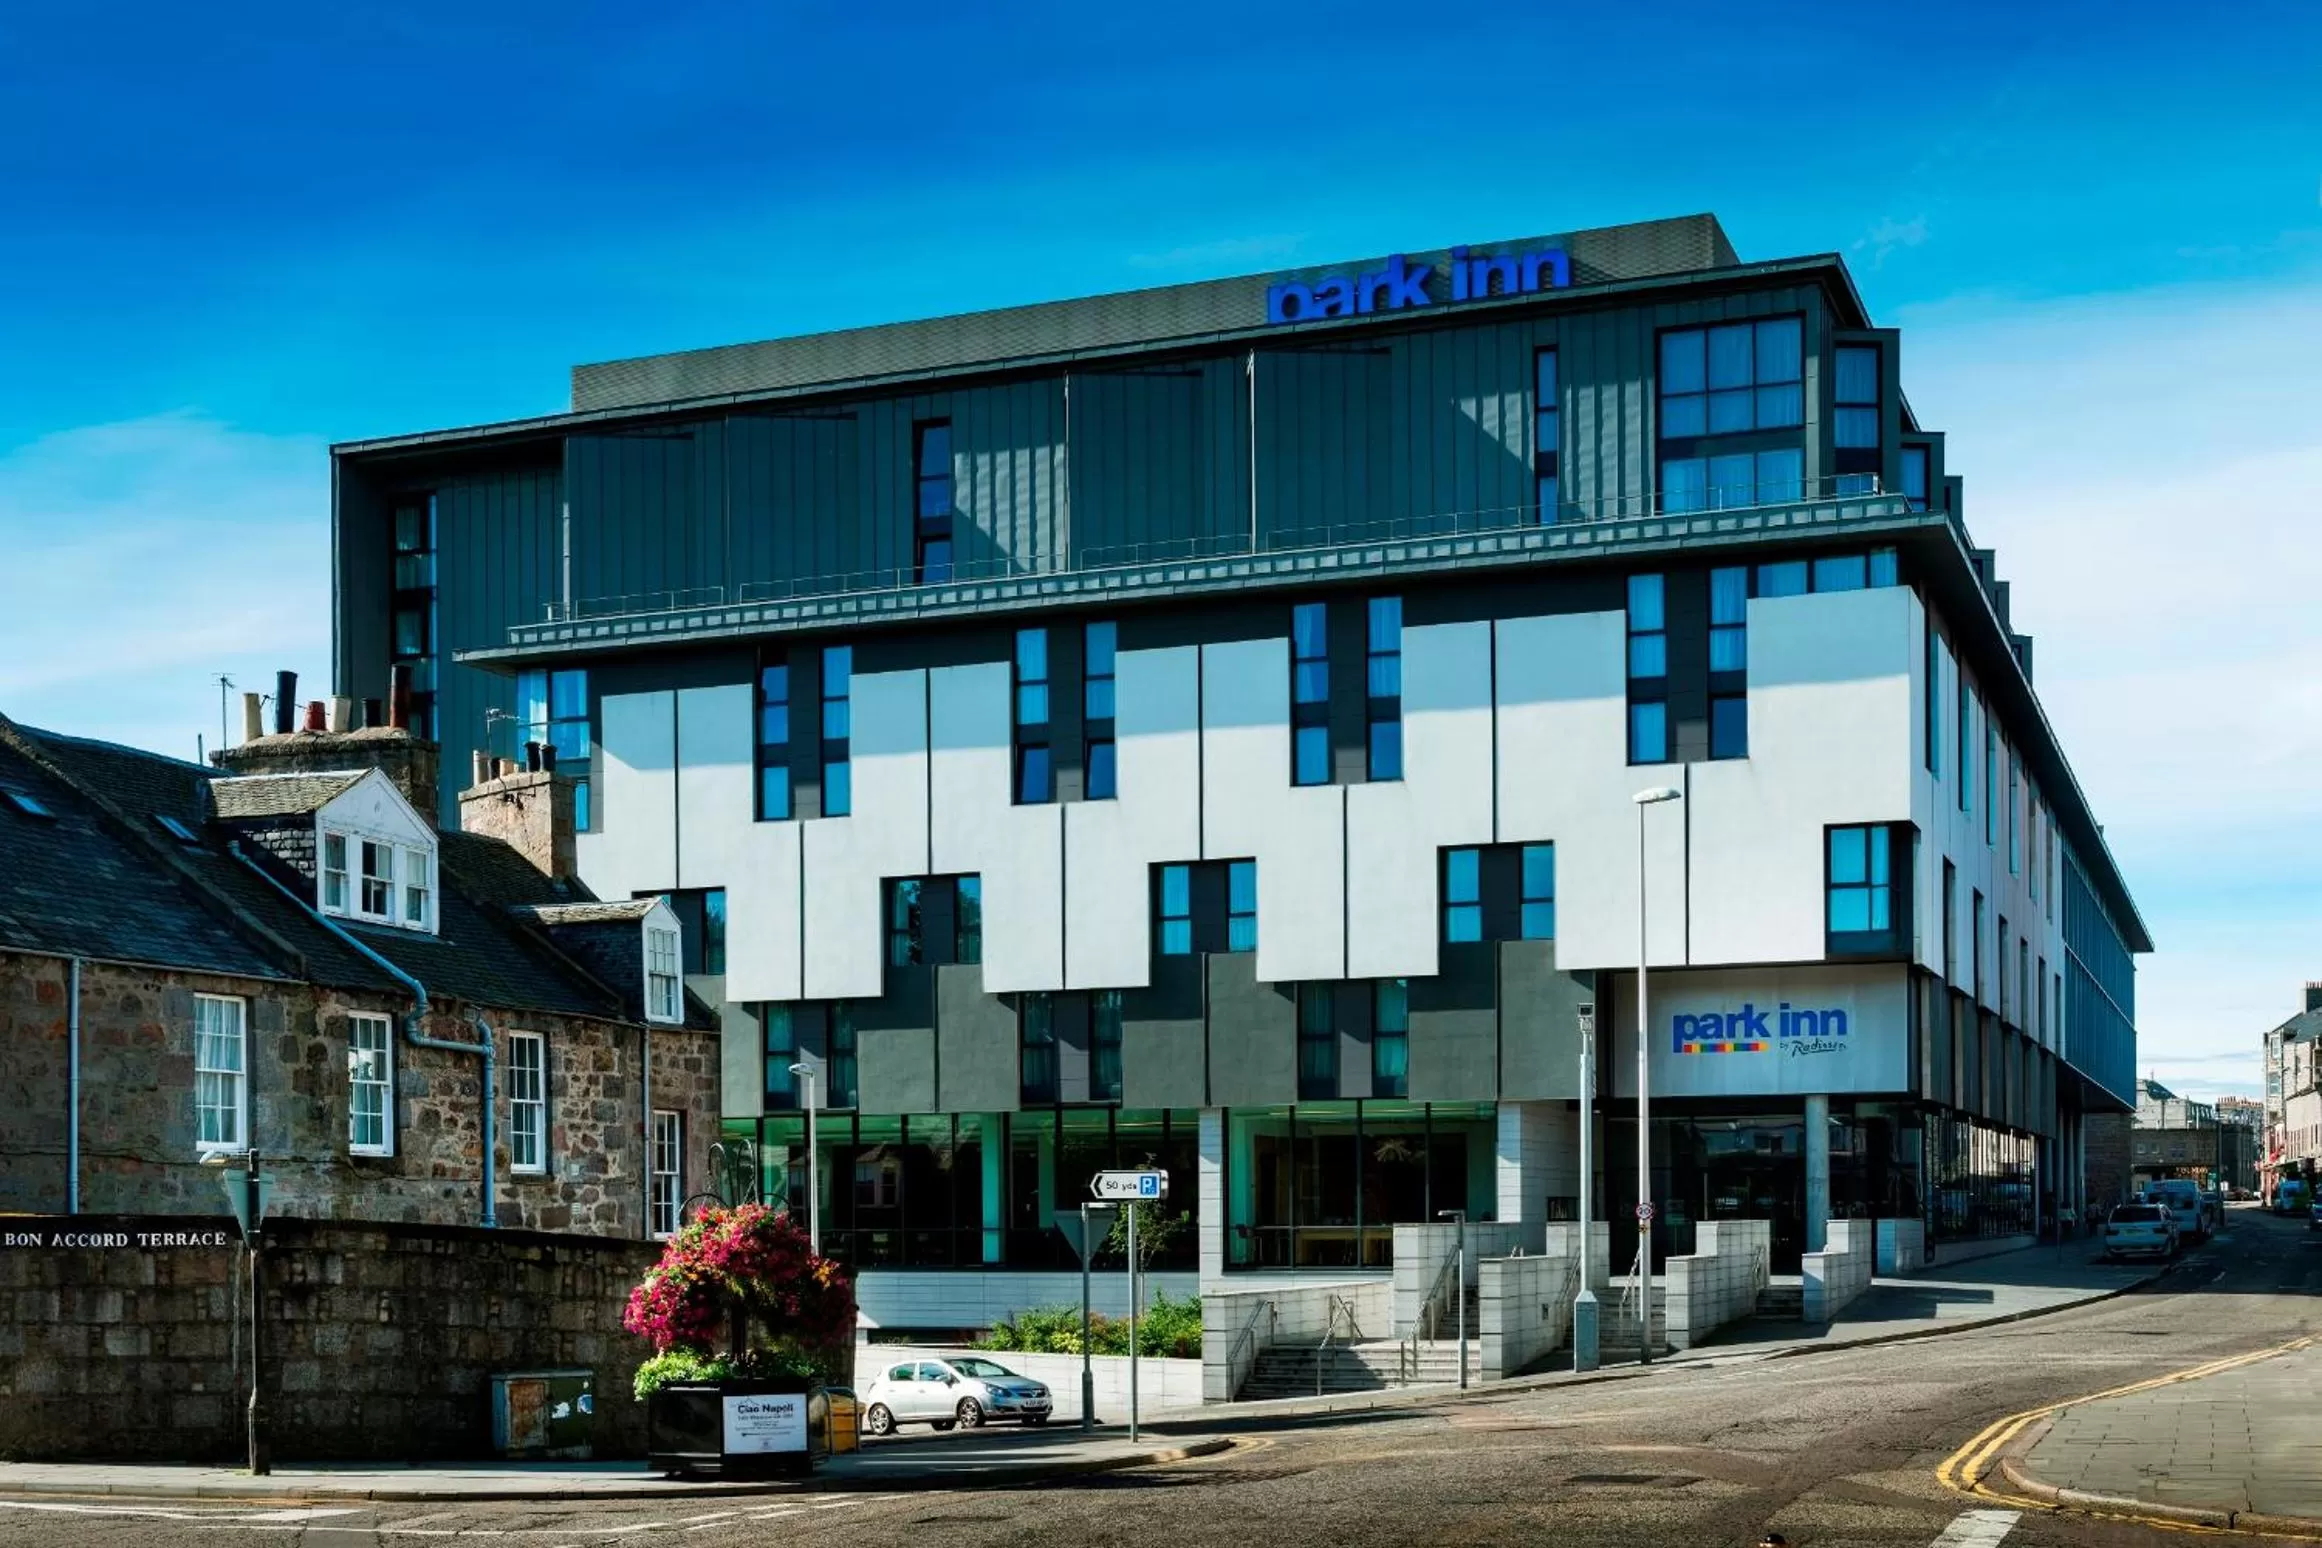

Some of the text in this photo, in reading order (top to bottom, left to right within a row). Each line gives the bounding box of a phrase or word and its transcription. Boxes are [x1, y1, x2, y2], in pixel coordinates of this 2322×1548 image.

[1267, 245, 1570, 324] park inn
[1673, 1003, 1847, 1053] park inn
[1780, 1042, 1789, 1051] by
[1106, 1181, 1137, 1192] 50 yds
[5, 1231, 227, 1247] BON ACCORD TERRACE
[738, 1403, 793, 1414] Ciao Napoli
